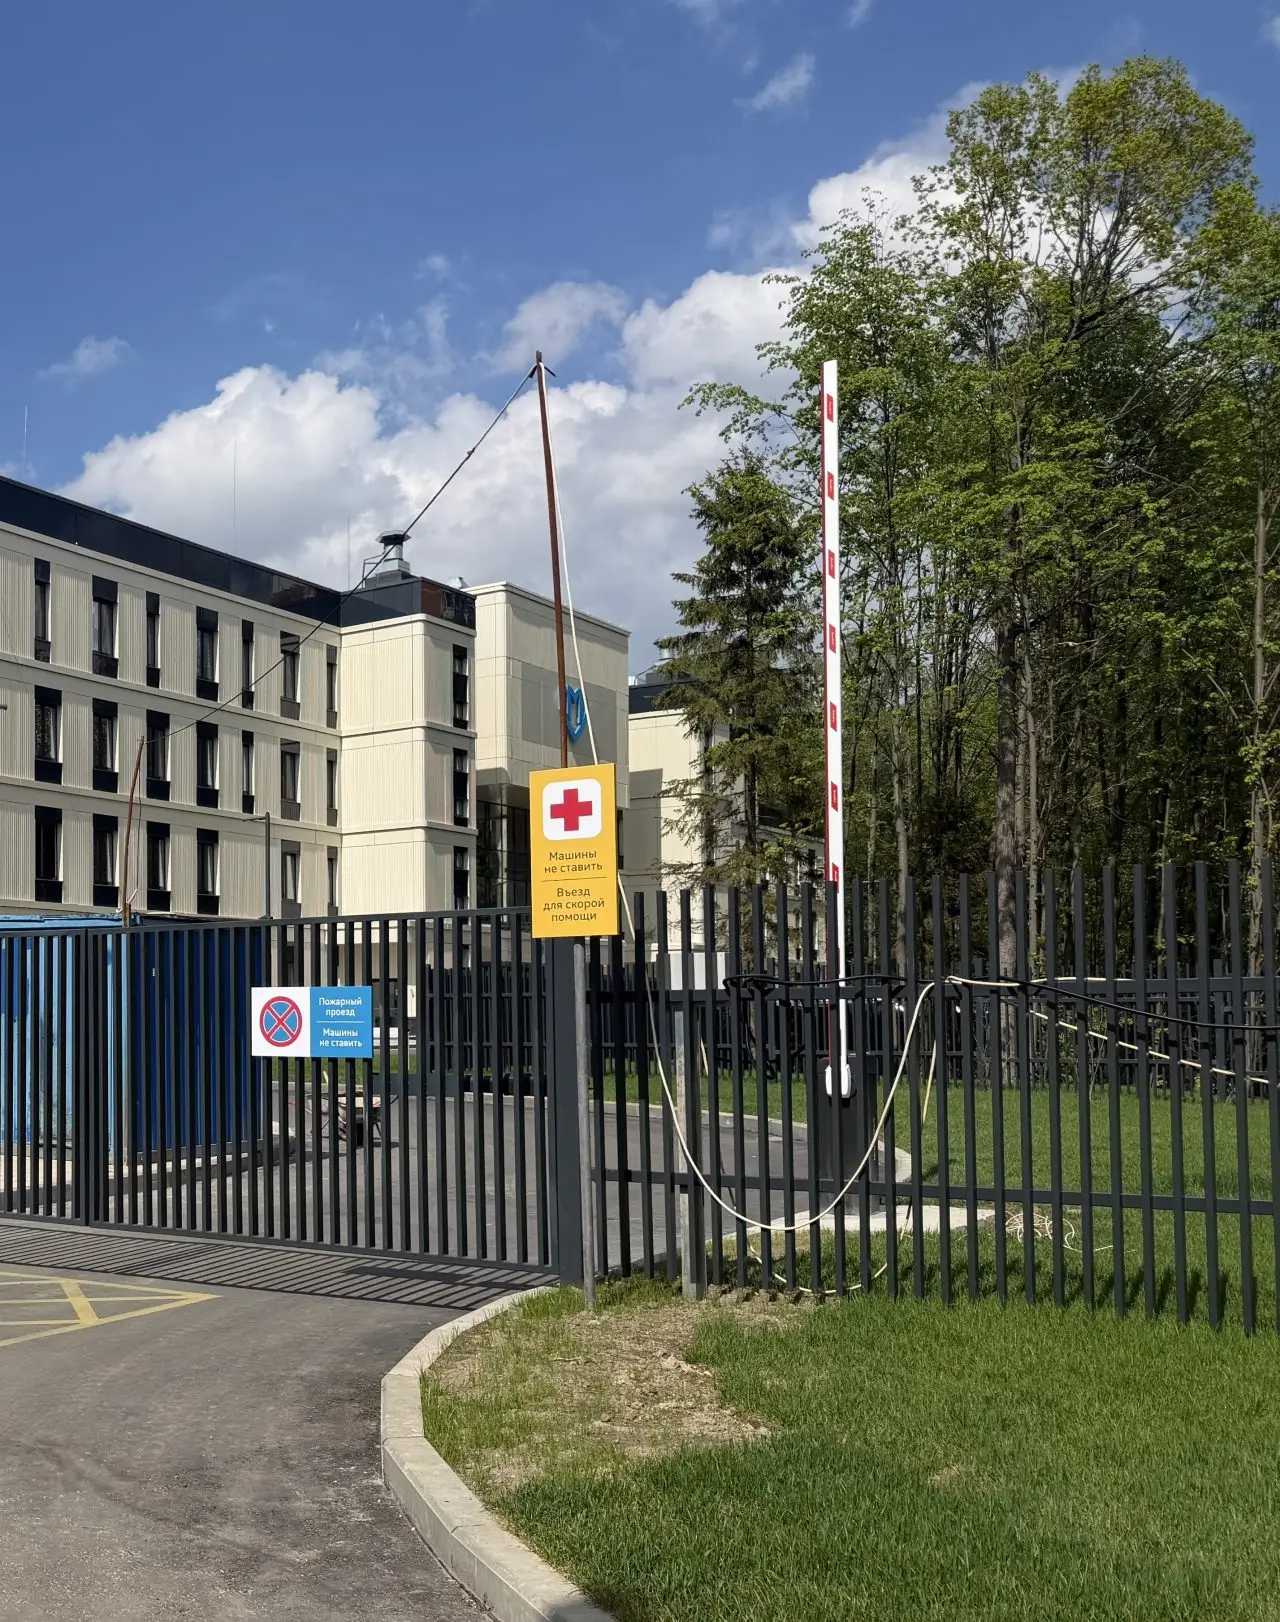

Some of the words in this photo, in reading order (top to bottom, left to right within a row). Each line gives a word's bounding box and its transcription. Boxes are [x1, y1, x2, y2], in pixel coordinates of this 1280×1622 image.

[549, 851, 597, 861] Машины
[544, 866, 557, 874] не
[560, 863, 603, 873] ставить
[557, 888, 591, 897] Въезд
[543, 902, 562, 912] для
[565, 898, 605, 911] скорой
[551, 913, 597, 922] помощи
[318, 996, 362, 1007] Пожарный
[325, 1009, 356, 1018] проезд
[322, 1028, 358, 1037] Машины
